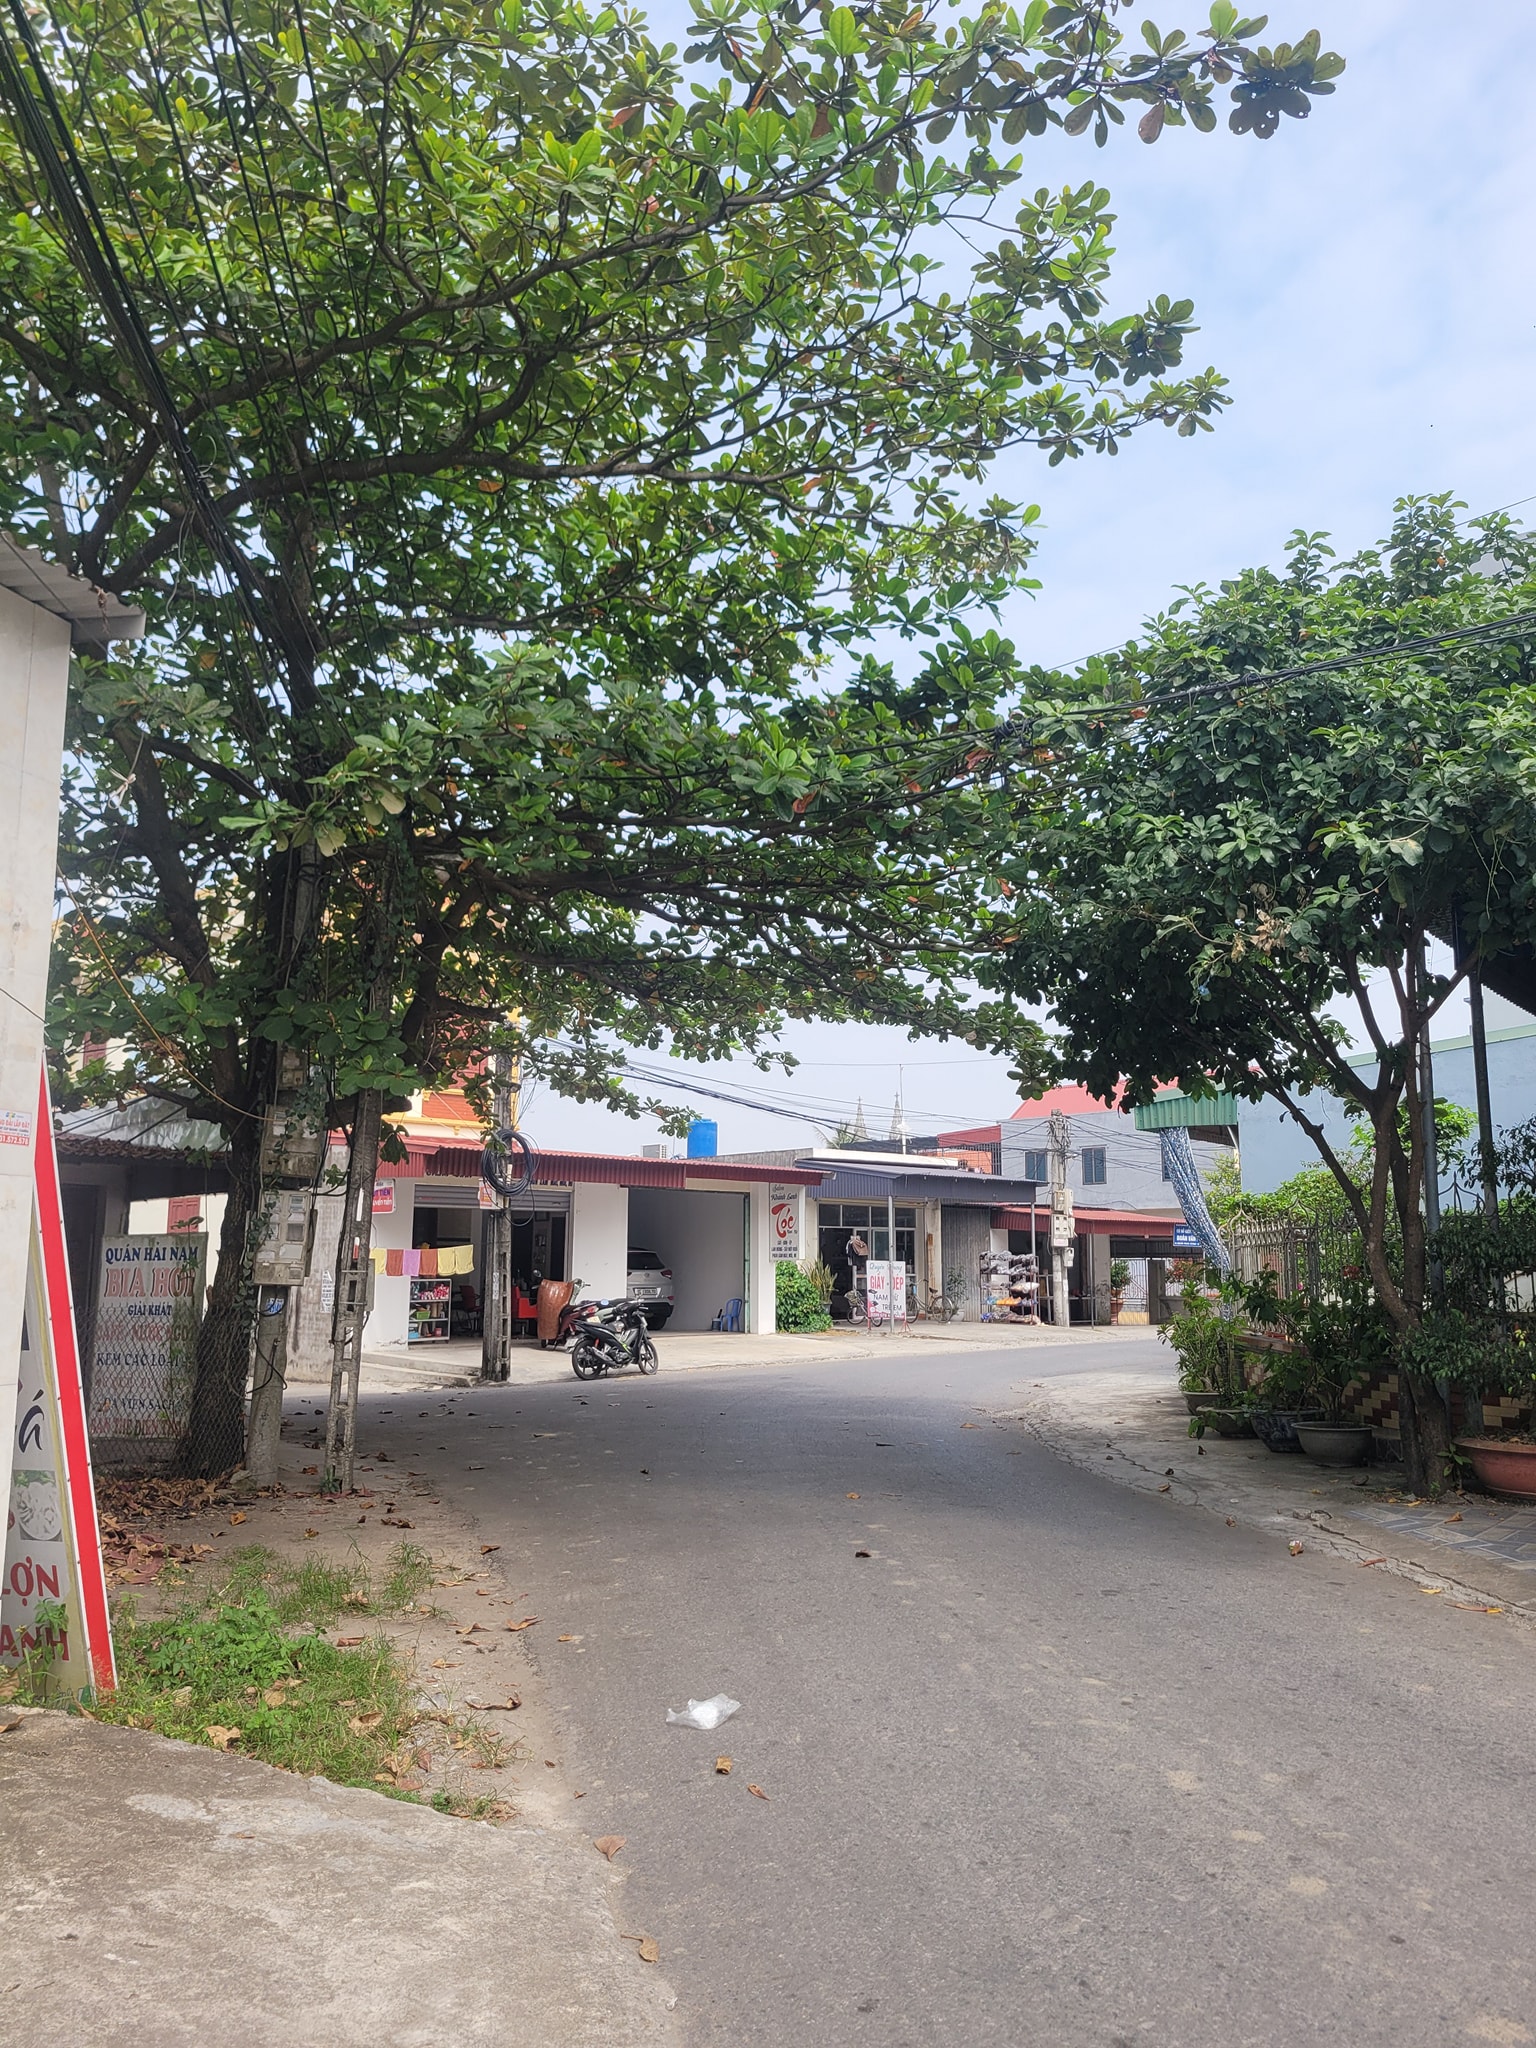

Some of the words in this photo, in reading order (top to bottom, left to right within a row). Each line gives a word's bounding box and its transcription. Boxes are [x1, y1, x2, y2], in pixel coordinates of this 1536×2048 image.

[105, 1244, 141, 1265] QUÁN
[144, 1241, 166, 1261] HẢI
[170, 1246, 198, 1261] NAM
[104, 1266, 146, 1298] BIA
